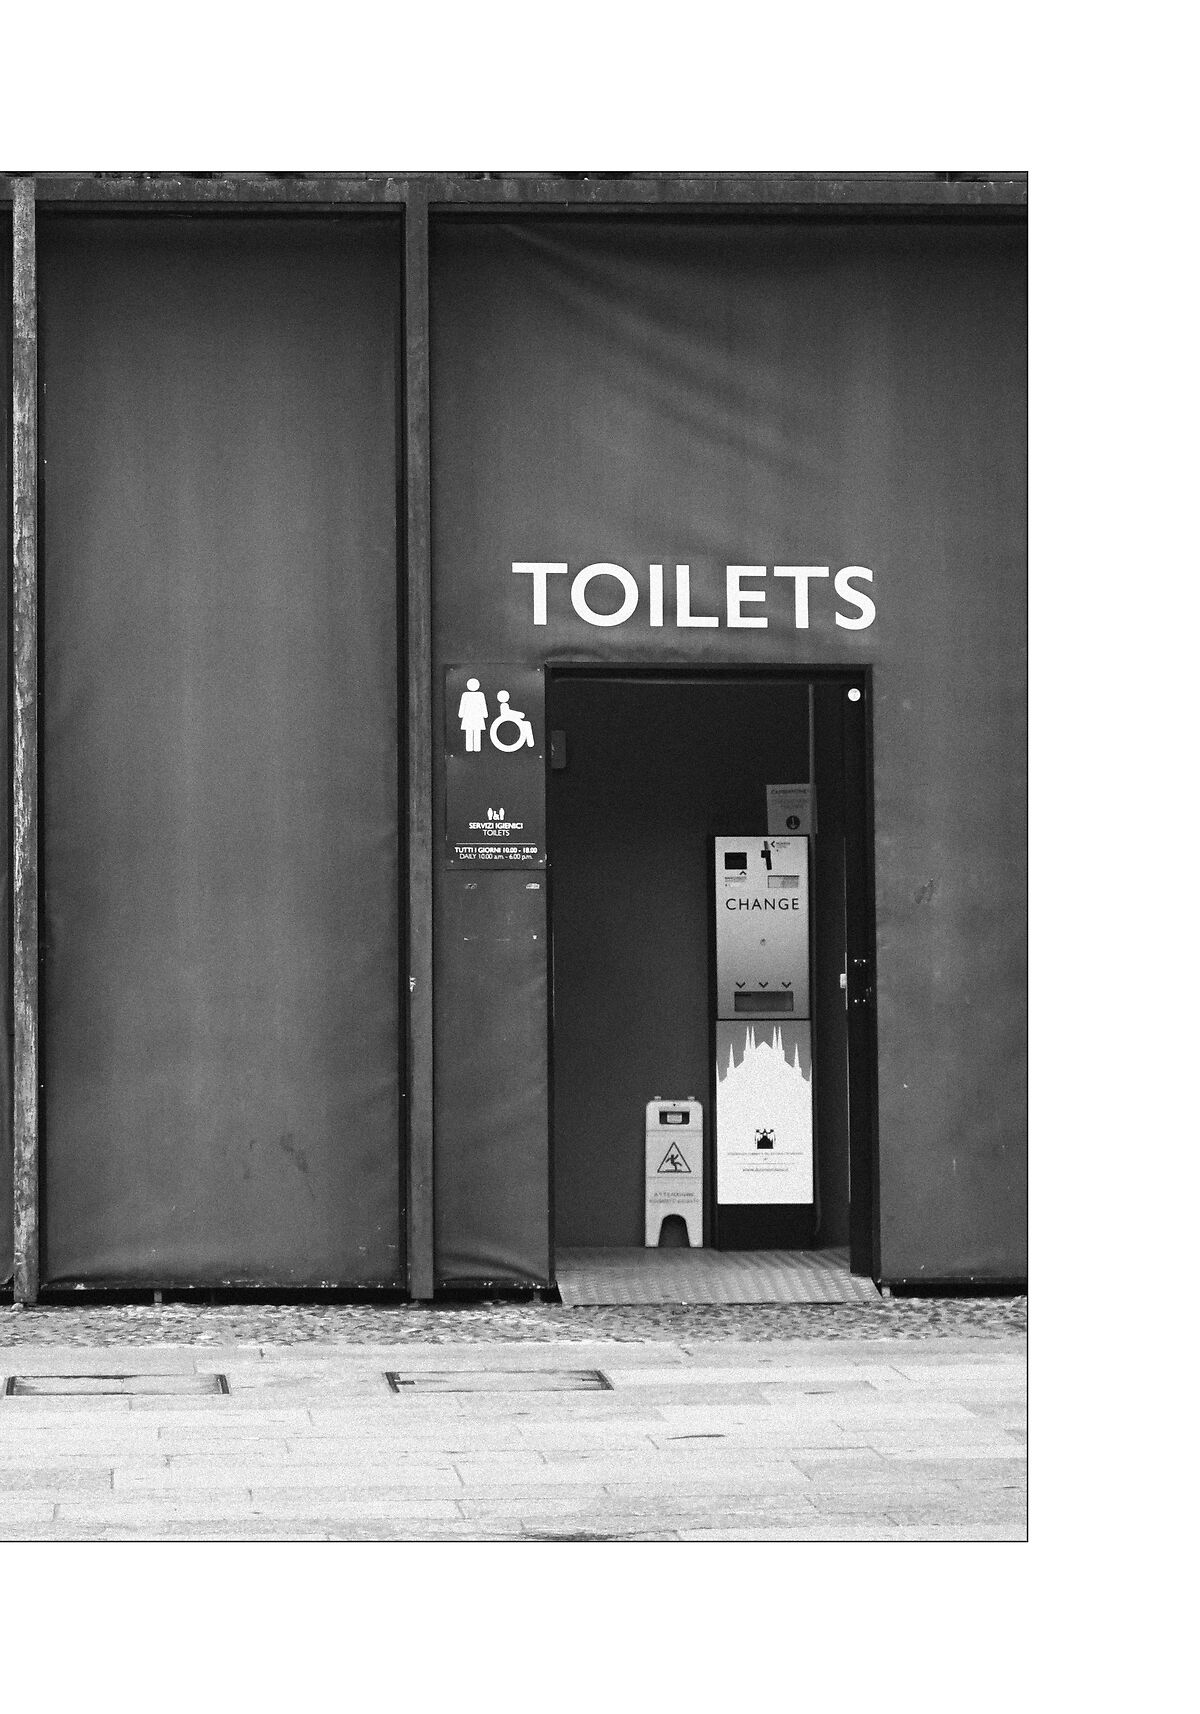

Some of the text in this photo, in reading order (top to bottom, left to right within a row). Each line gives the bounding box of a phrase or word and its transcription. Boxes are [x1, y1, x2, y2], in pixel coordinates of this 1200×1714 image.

[512, 563, 876, 631] TOILETS
[468, 822, 524, 830] SERVIZI IGIENICI
[482, 829, 511, 837] TOILETS
[725, 898, 800, 911] CHANGE
